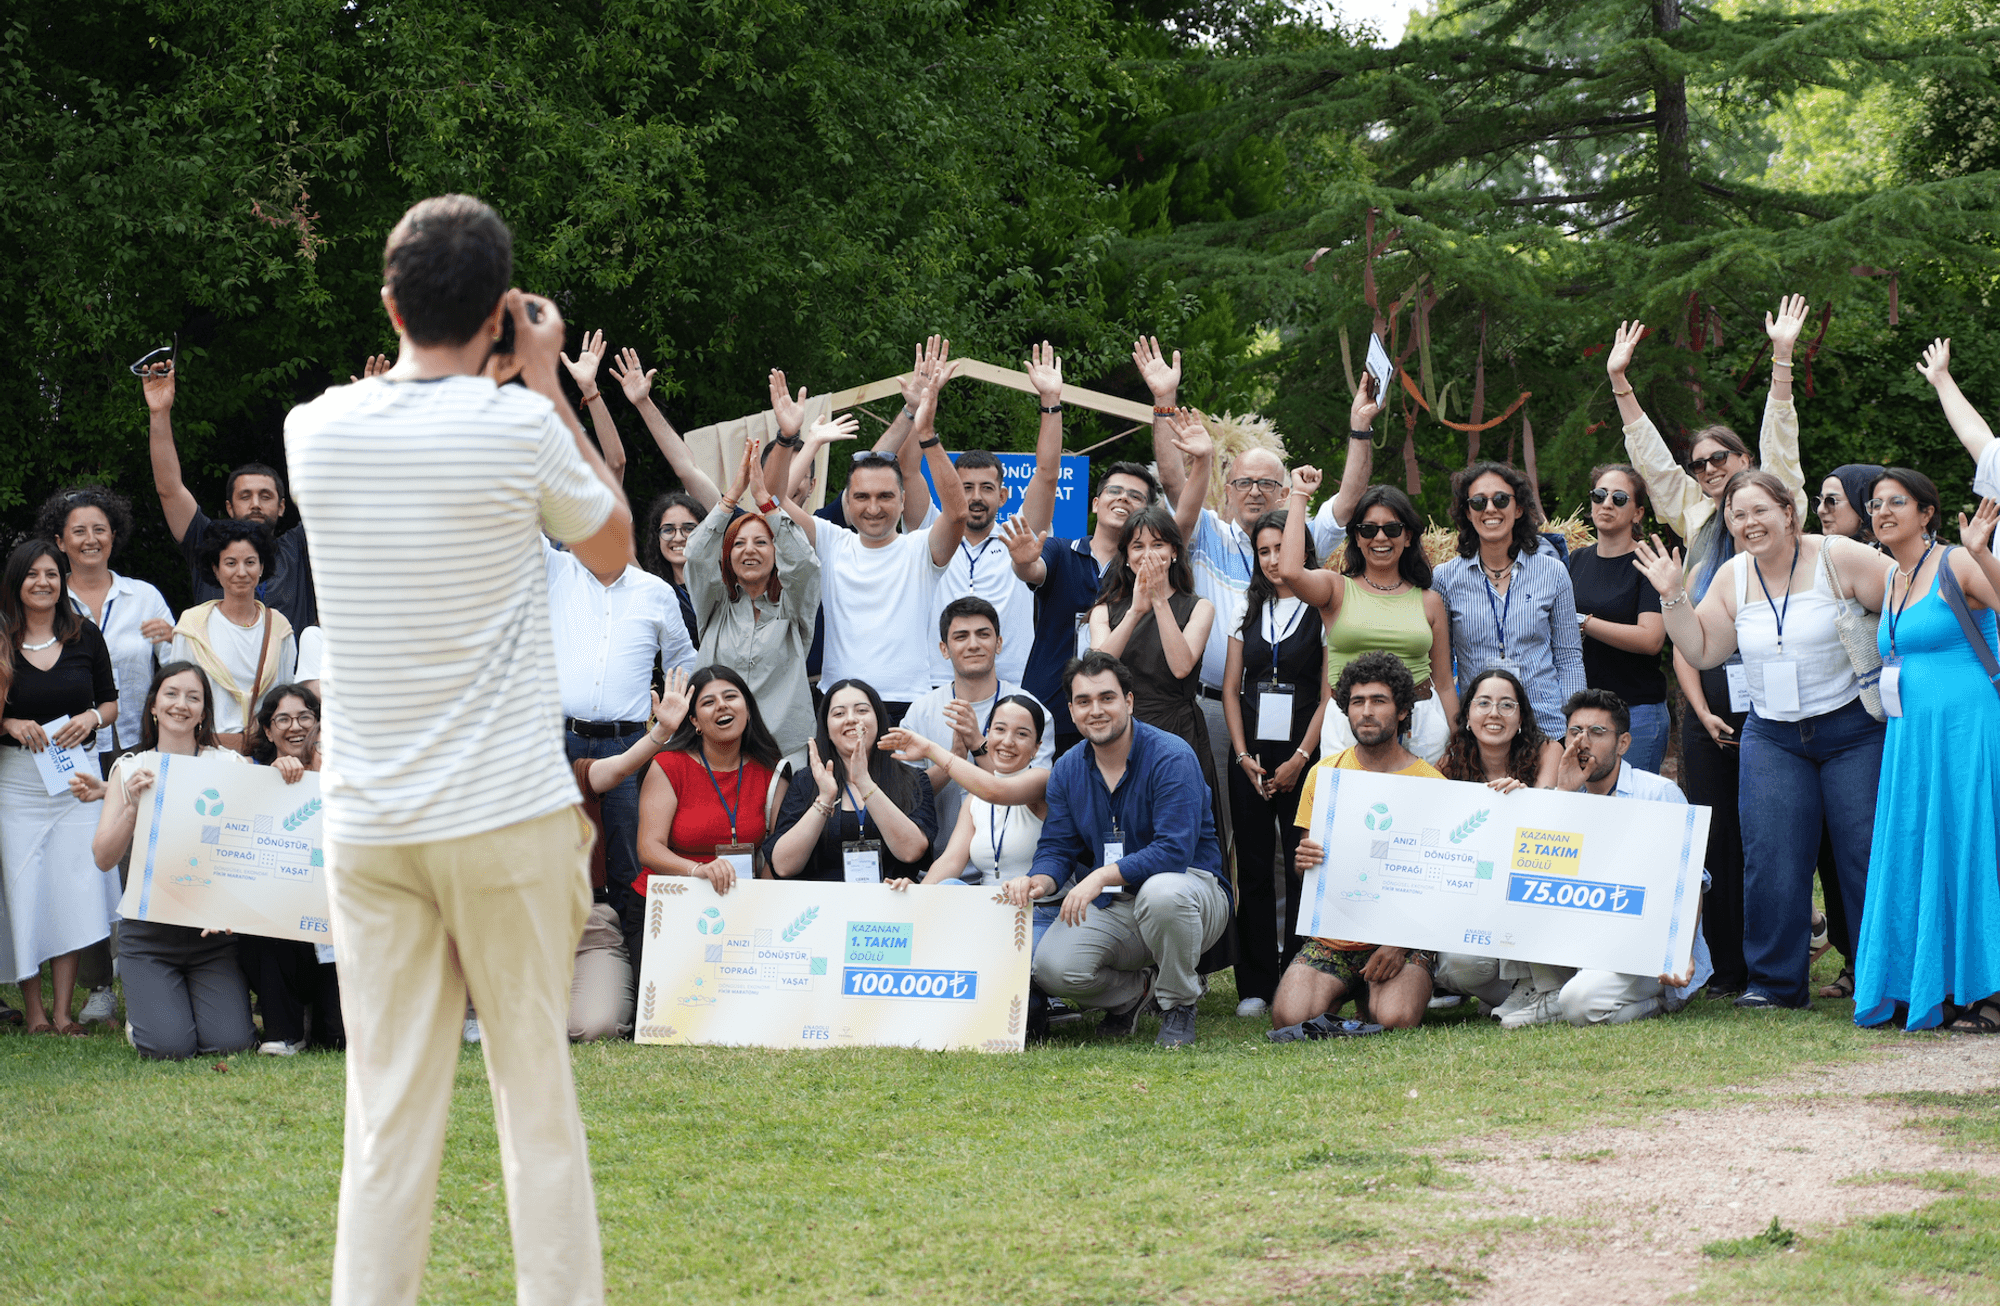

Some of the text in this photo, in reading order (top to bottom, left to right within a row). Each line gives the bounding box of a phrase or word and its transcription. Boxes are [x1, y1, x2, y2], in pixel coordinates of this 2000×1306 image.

[225, 822, 250, 832] ANIZI
[1393, 836, 1417, 846] ANIZI
[1520, 830, 1570, 843] KAZANAN
[257, 837, 310, 852] DÖNÜŞTÜR,
[1518, 842, 1579, 859] 2. TAKIM
[216, 848, 256, 860] TOPRAĞI
[1424, 850, 1475, 864] DÖNÜŞTÜR,
[1384, 863, 1422, 875] TOPRAĞI
[1516, 857, 1552, 870] ÖDÜLÜ
[280, 865, 309, 876] YAŞAT
[1446, 879, 1474, 889] YAŞAT
[301, 915, 328, 923] ANADOLU
[299, 920, 328, 932] EFES
[851, 924, 901, 933] KAZANAN
[1465, 928, 1492, 936] ANADOLU
[727, 939, 750, 948] ANIZI
[851, 936, 908, 948] 1. TAKIM
[1463, 933, 1492, 946] EFES
[758, 949, 809, 961] DÖNÜŞTÜR,
[849, 949, 884, 962] ÖDÜLÜ
[720, 966, 757, 975] TOPRAĞI
[781, 977, 809, 986] YAŞAT
[802, 1029, 830, 1040] EFES
